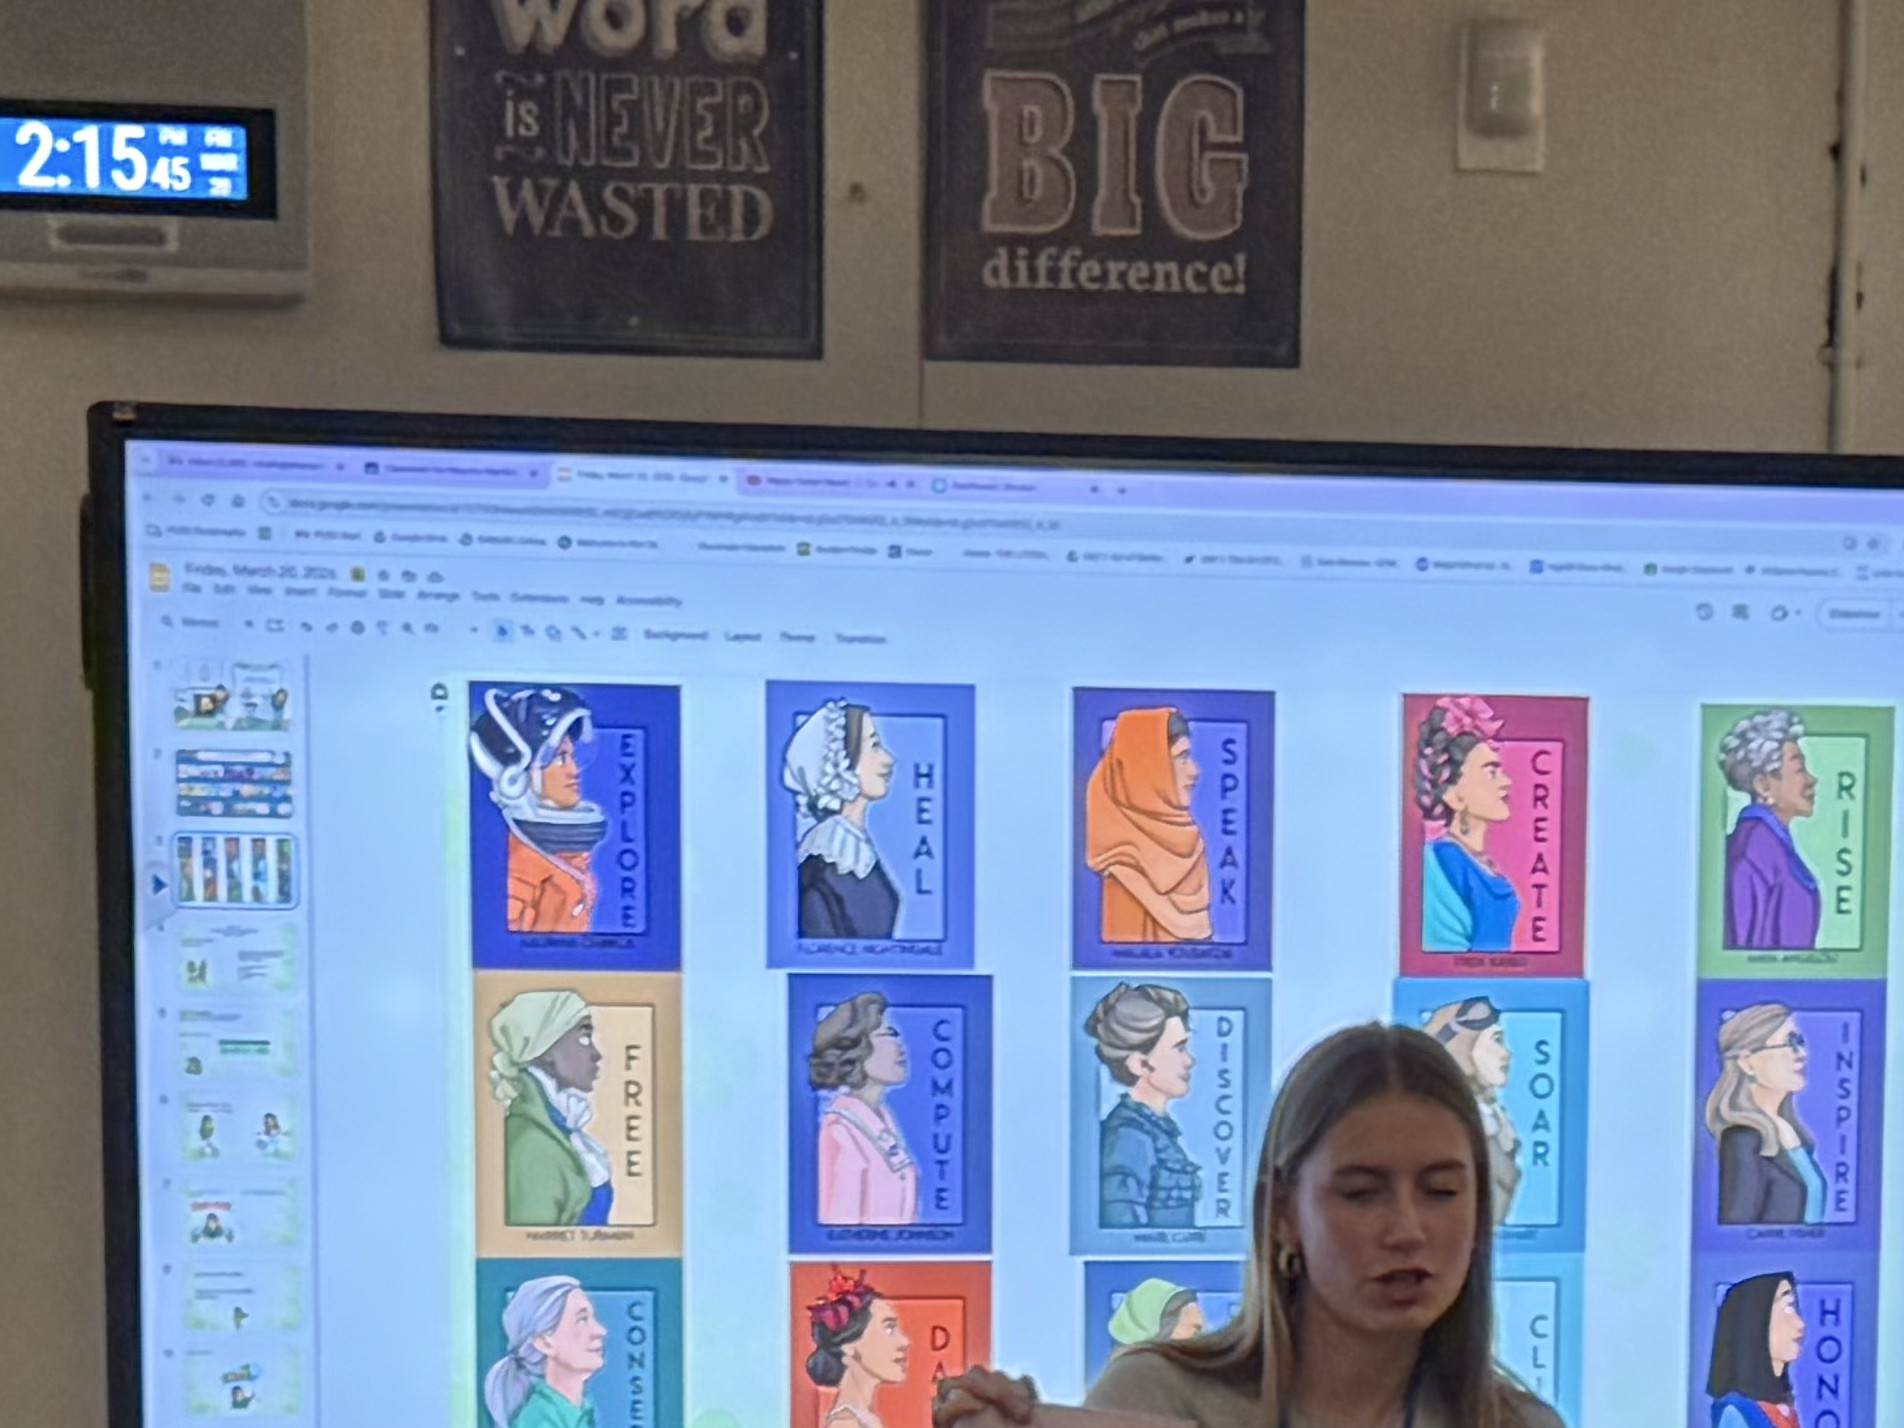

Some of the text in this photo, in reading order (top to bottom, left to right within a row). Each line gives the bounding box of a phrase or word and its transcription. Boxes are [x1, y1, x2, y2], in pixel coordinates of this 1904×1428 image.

[15, 121, 148, 191] 2:15
[151, 157, 191, 191] 45
[505, 70, 772, 173] is NEVER
[982, 68, 1249, 240] BIG
[492, 176, 774, 242] WASTED
[982, 246, 1246, 295] difference!
[617, 733, 640, 930] EXPLORE
[912, 763, 935, 896] HEAL
[1218, 738, 1239, 906] SPEAK
[1529, 750, 1553, 944] CREATE
[1835, 771, 1857, 916] RISE
[623, 1044, 643, 1178] FREE
[931, 1019, 954, 1211] COMPUTE
[1213, 1016, 1235, 1219] DISCOVER
[1529, 1040, 1555, 1167] SOAR
[1834, 1021, 1856, 1213] INSPIRE
